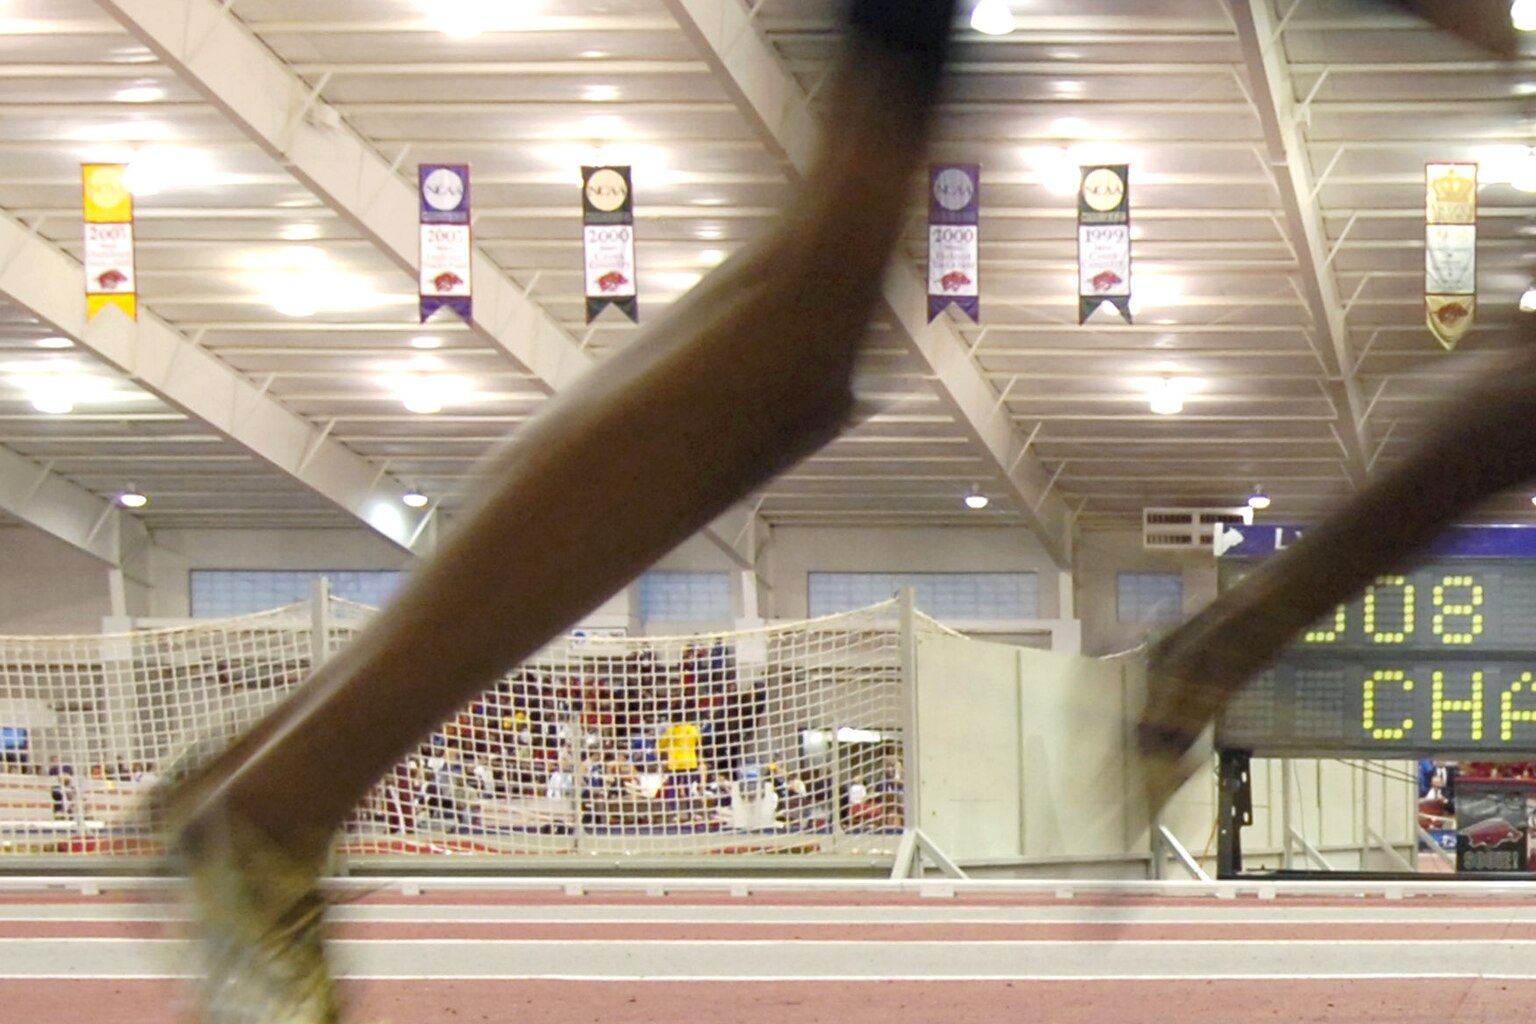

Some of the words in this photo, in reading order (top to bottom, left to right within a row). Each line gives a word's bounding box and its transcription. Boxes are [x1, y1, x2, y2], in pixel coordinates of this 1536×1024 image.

[589, 228, 629, 243] 2000
[933, 228, 974, 243] 2000
[1085, 228, 1125, 243] 1999
